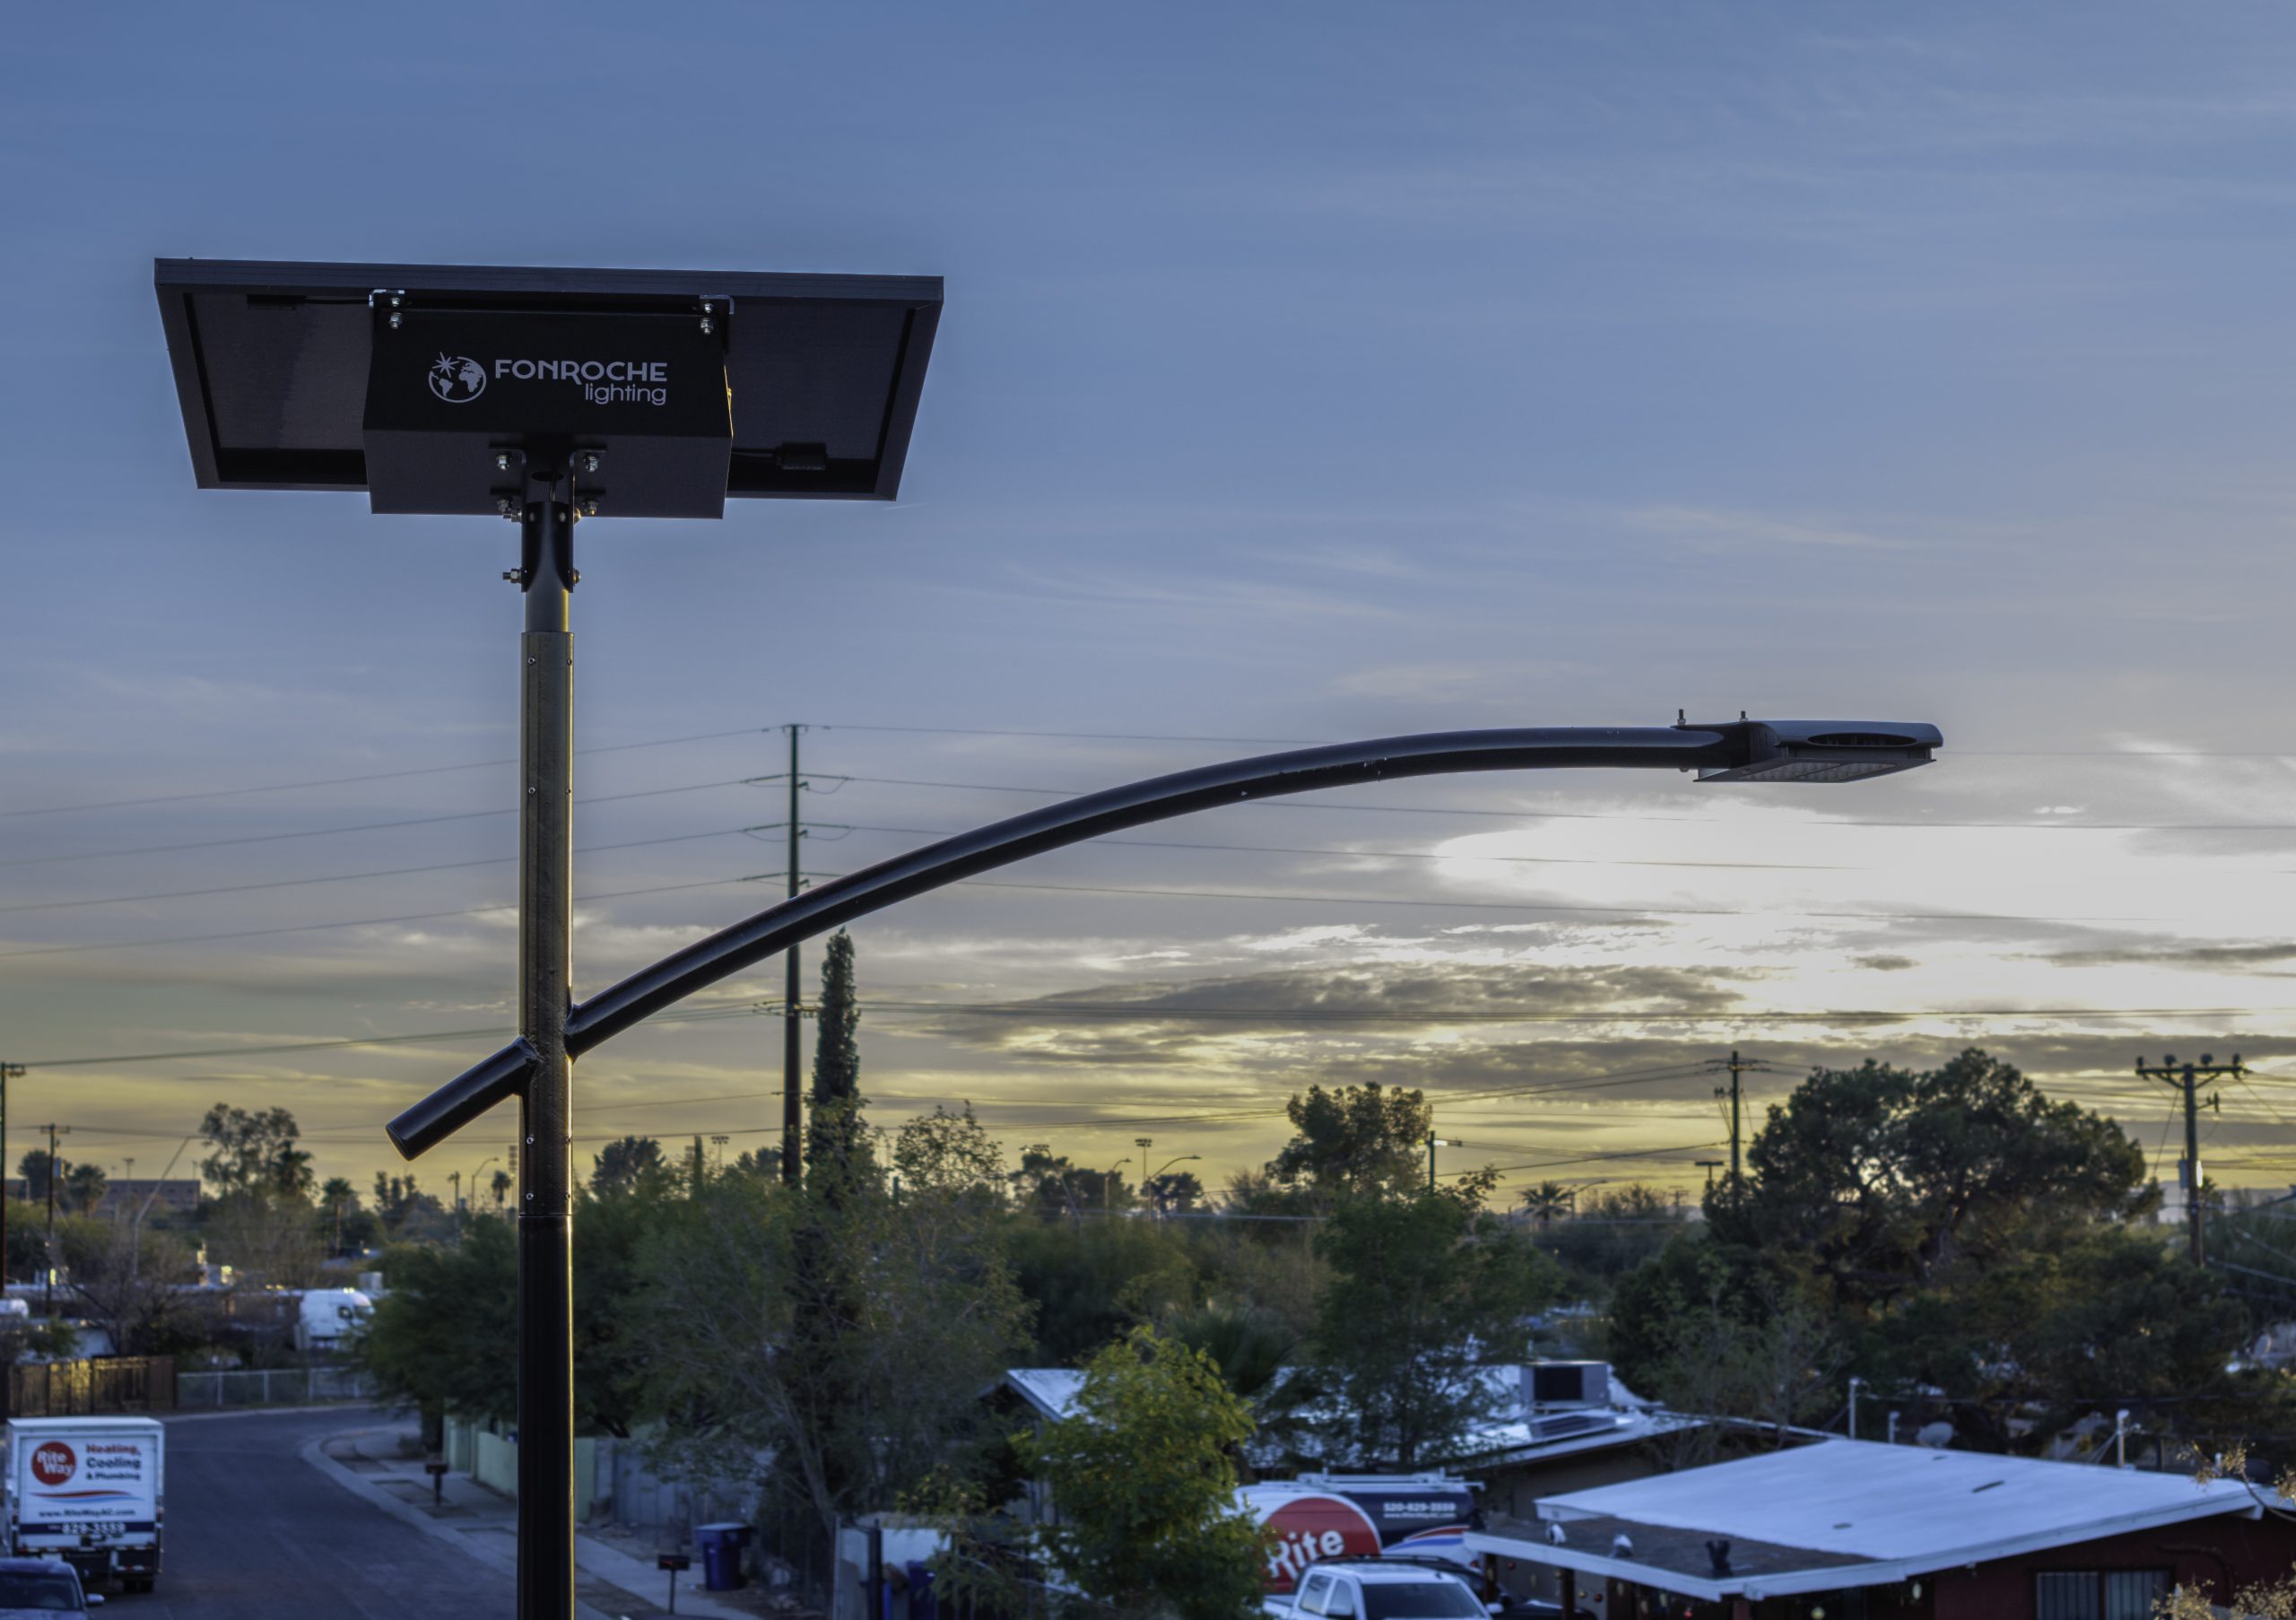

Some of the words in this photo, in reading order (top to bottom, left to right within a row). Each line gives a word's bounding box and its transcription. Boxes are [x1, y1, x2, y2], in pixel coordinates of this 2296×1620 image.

[495, 359, 668, 385] FONROCHE
[585, 383, 667, 405] lighting
[37, 1450, 67, 1463] Rite
[86, 1457, 142, 1469] Cooling
[43, 1462, 74, 1476] Way
[95, 1473, 142, 1481] Plumbing
[1265, 1530, 1344, 1580] Rite
